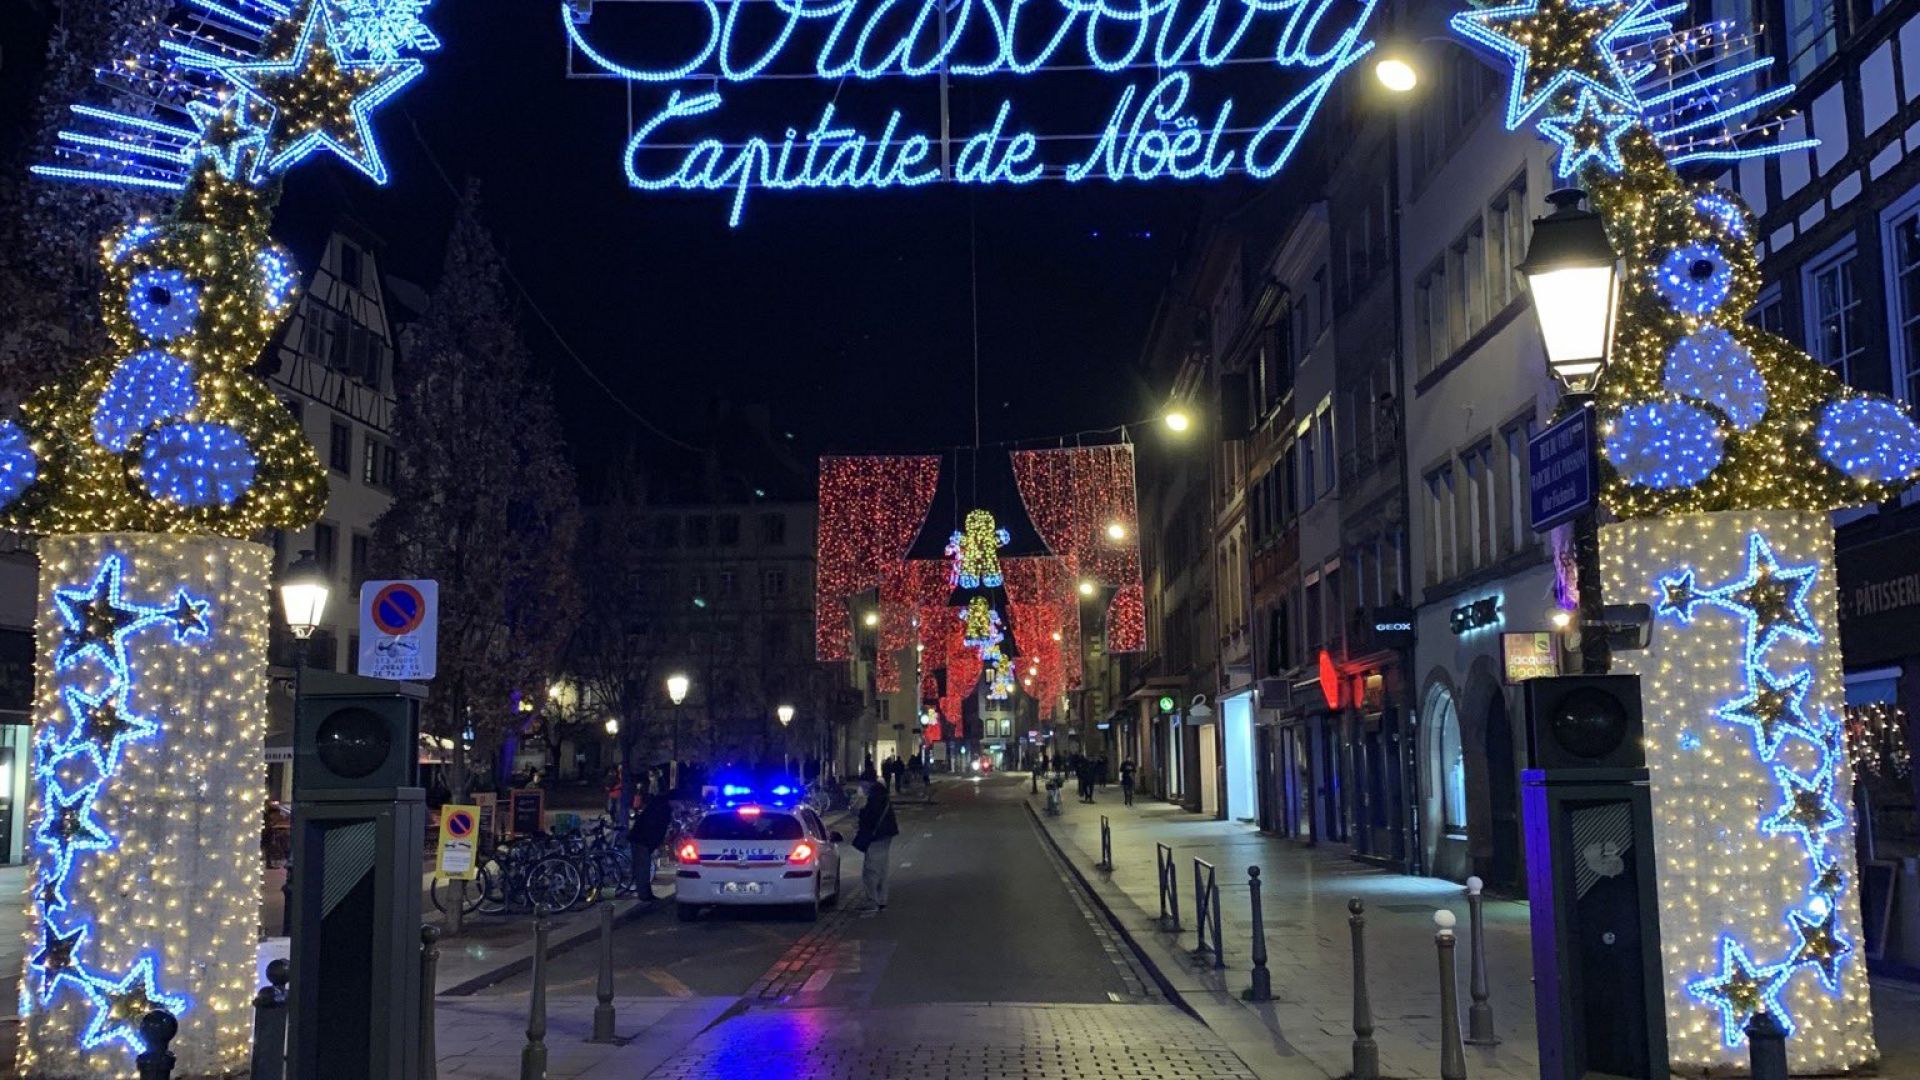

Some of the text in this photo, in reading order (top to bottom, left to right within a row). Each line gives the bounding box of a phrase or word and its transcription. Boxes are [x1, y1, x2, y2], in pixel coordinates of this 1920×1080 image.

[624, 70, 1236, 228] Capitale de Noël
[1855, 573, 1920, 616] PÂTISSERI
[1376, 623, 1411, 631] GEOX
[1509, 654, 1555, 667] Jacques
[1509, 664, 1555, 680] Bockel
